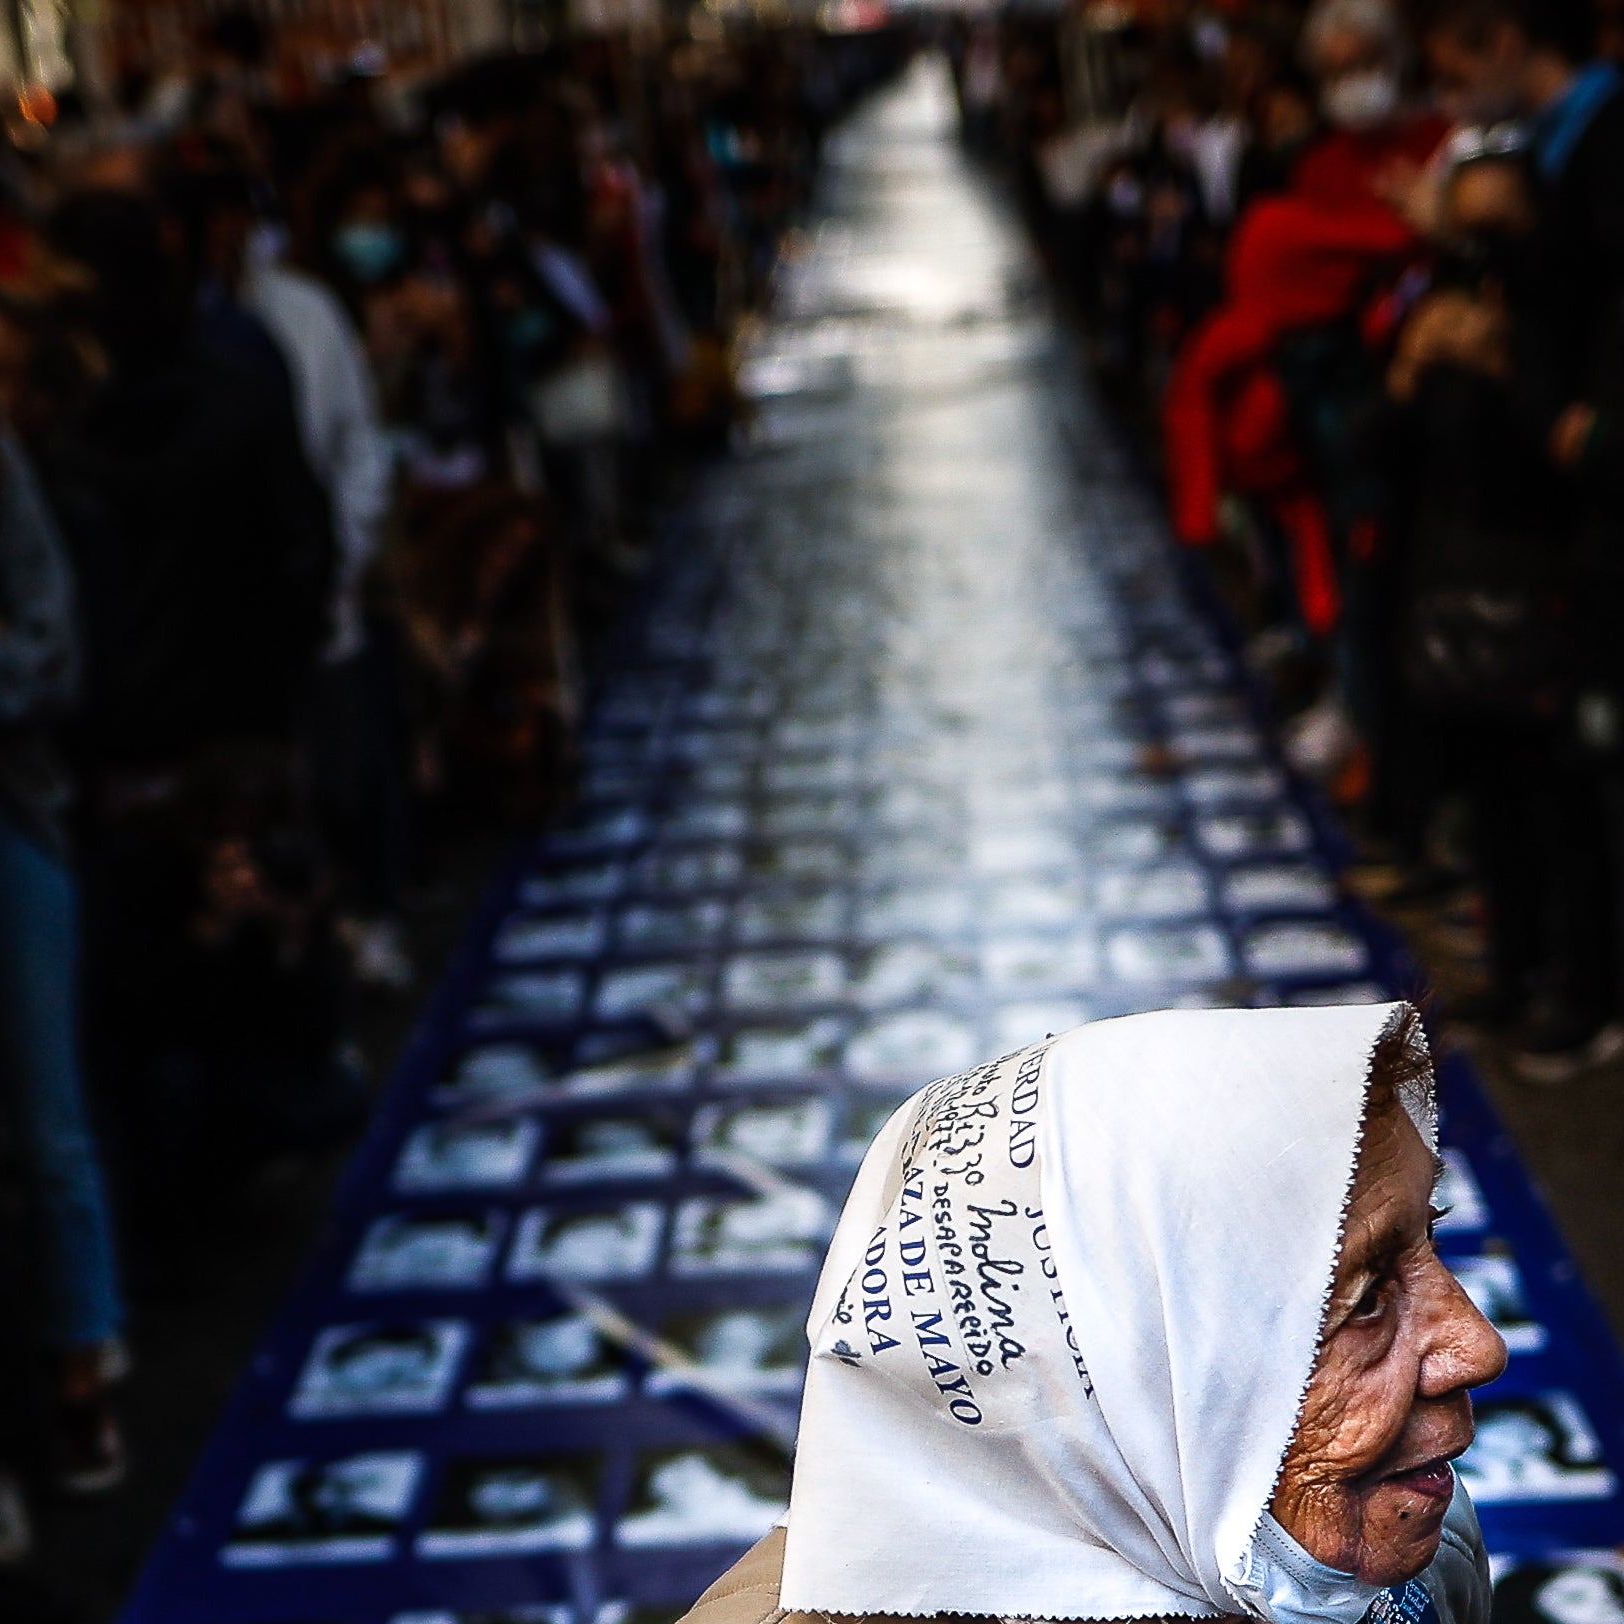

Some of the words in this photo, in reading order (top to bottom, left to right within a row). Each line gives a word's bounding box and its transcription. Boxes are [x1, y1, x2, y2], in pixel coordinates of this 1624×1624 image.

[898, 1166, 925, 1233] AZA
[899, 1236, 936, 1297] DE
[967, 1199, 1026, 1371] Molina
[910, 1308, 983, 1427] MAYO
